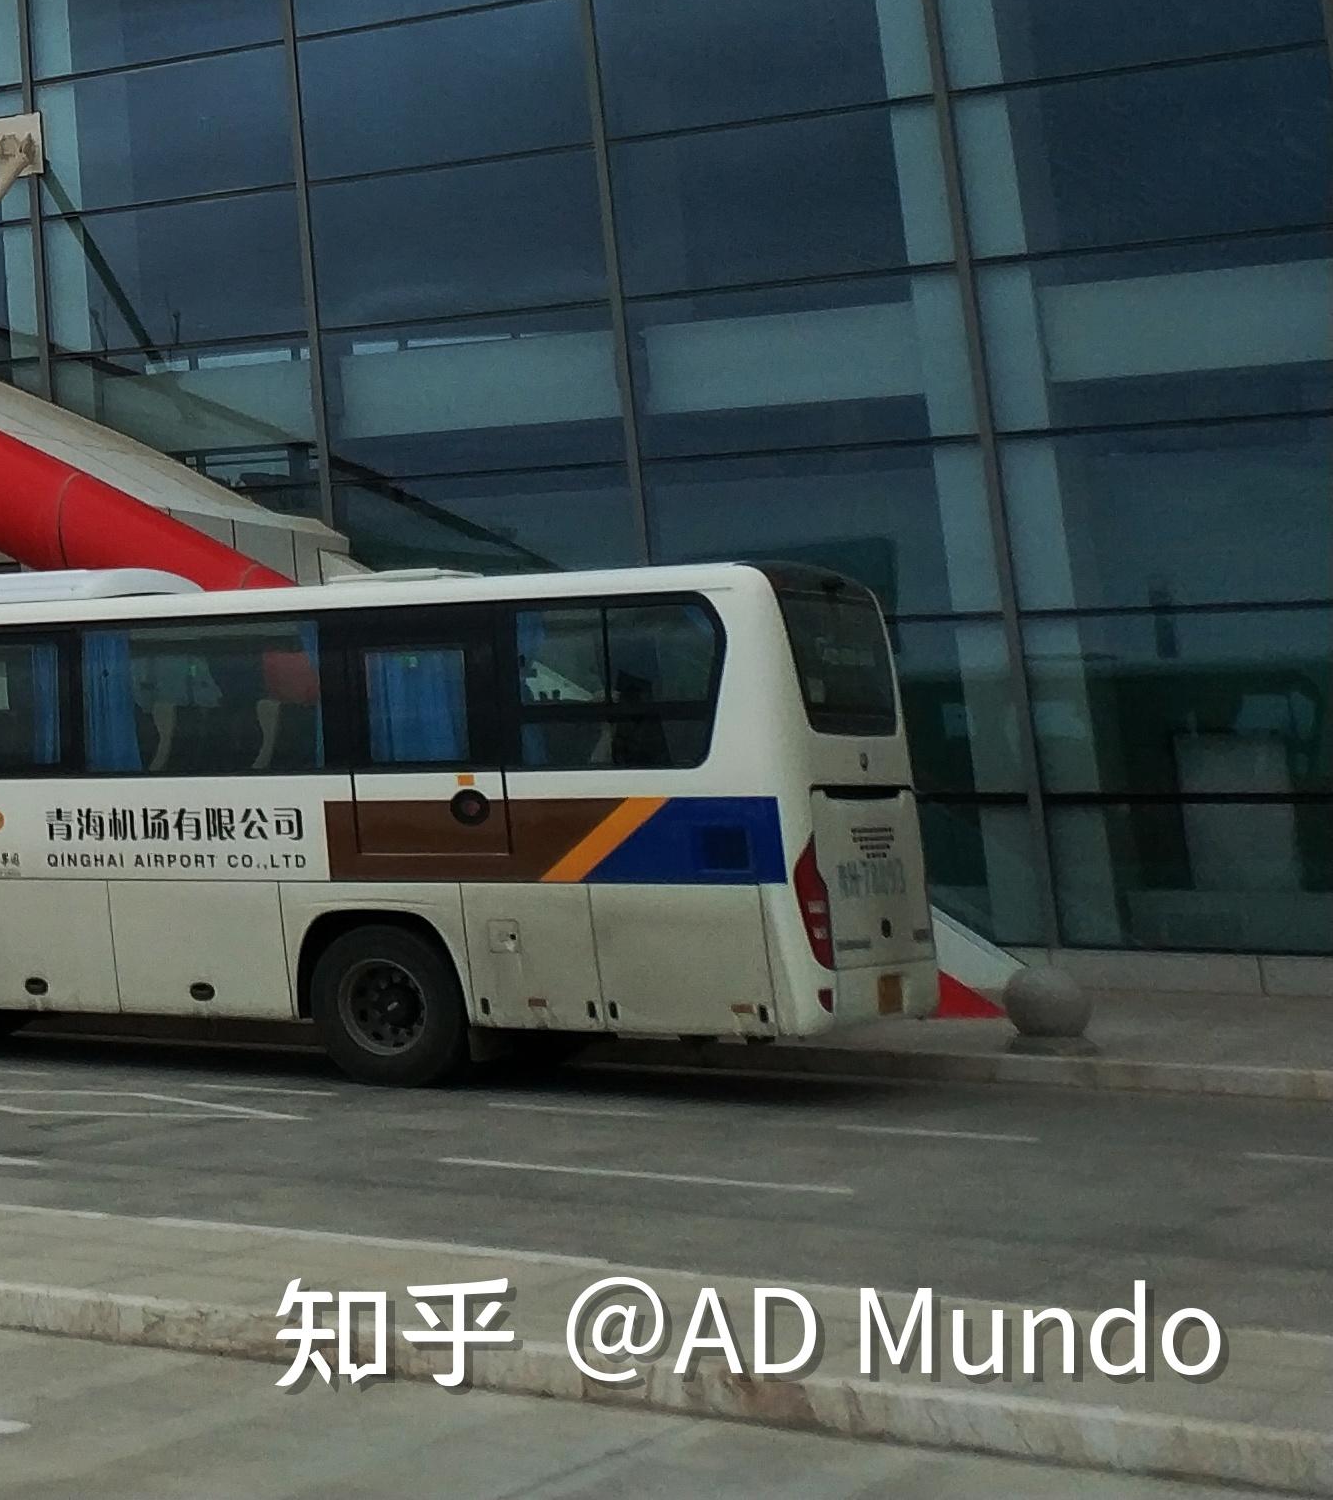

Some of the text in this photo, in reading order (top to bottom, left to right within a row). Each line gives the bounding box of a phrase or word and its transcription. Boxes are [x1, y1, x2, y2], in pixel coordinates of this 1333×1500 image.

[45, 806, 305, 842] 青海机场有限公司
[46, 852, 125, 869] QINGHAI
[133, 852, 216, 869] AIRPORT
